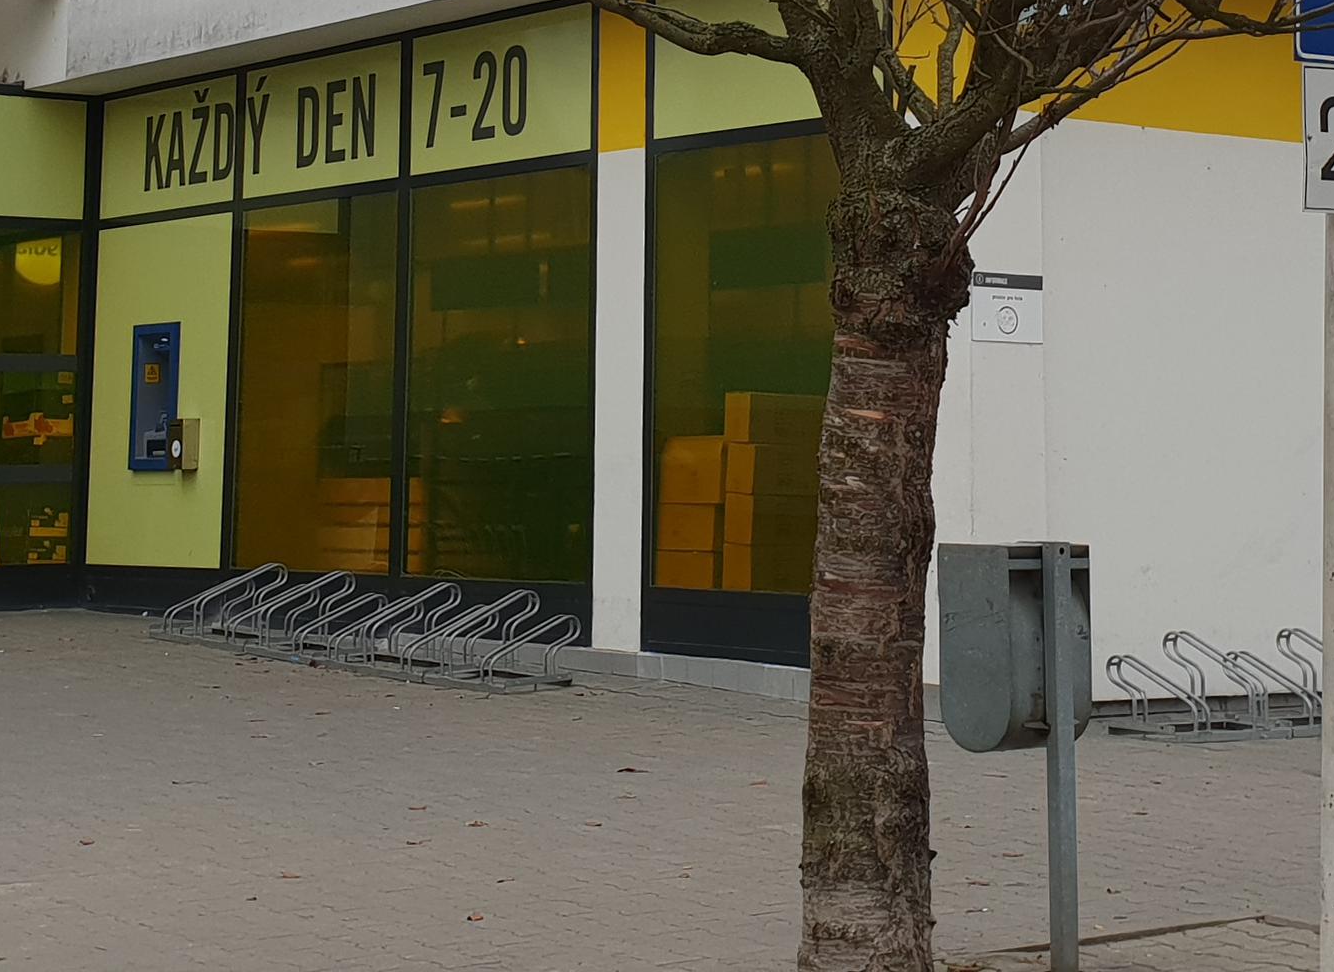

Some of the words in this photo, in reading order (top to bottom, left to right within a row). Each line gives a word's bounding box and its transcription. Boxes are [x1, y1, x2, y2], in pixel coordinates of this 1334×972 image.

[144, 76, 270, 192] KAŽDÝ
[296, 73, 377, 169] DEN
[423, 45, 527, 149] 7-20
